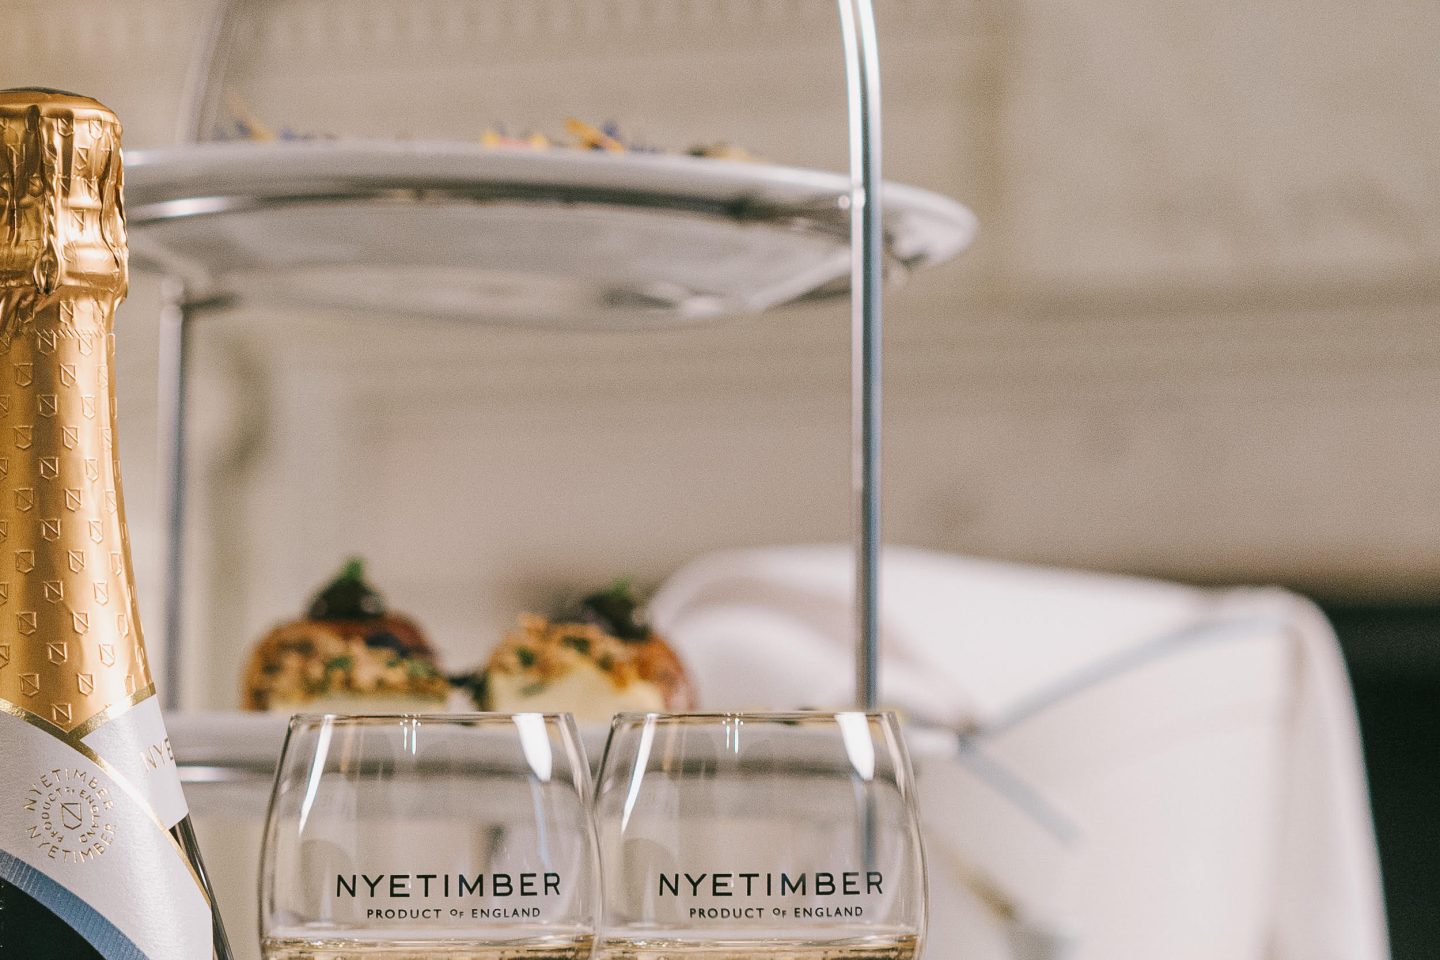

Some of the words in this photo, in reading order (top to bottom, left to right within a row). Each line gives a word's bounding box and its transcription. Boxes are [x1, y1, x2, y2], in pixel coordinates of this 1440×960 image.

[23, 768, 114, 812] NYETIMBER
[335, 872, 561, 898] NYETIMBER
[659, 871, 884, 897] NYETIMBER
[366, 907, 442, 920] PRODUCT
[449, 908, 464, 919] OF
[471, 907, 541, 919] ENGLAND
[689, 906, 765, 919] PRODUCT
[772, 907, 787, 919] OF
[793, 906, 864, 918] ENGLAND
